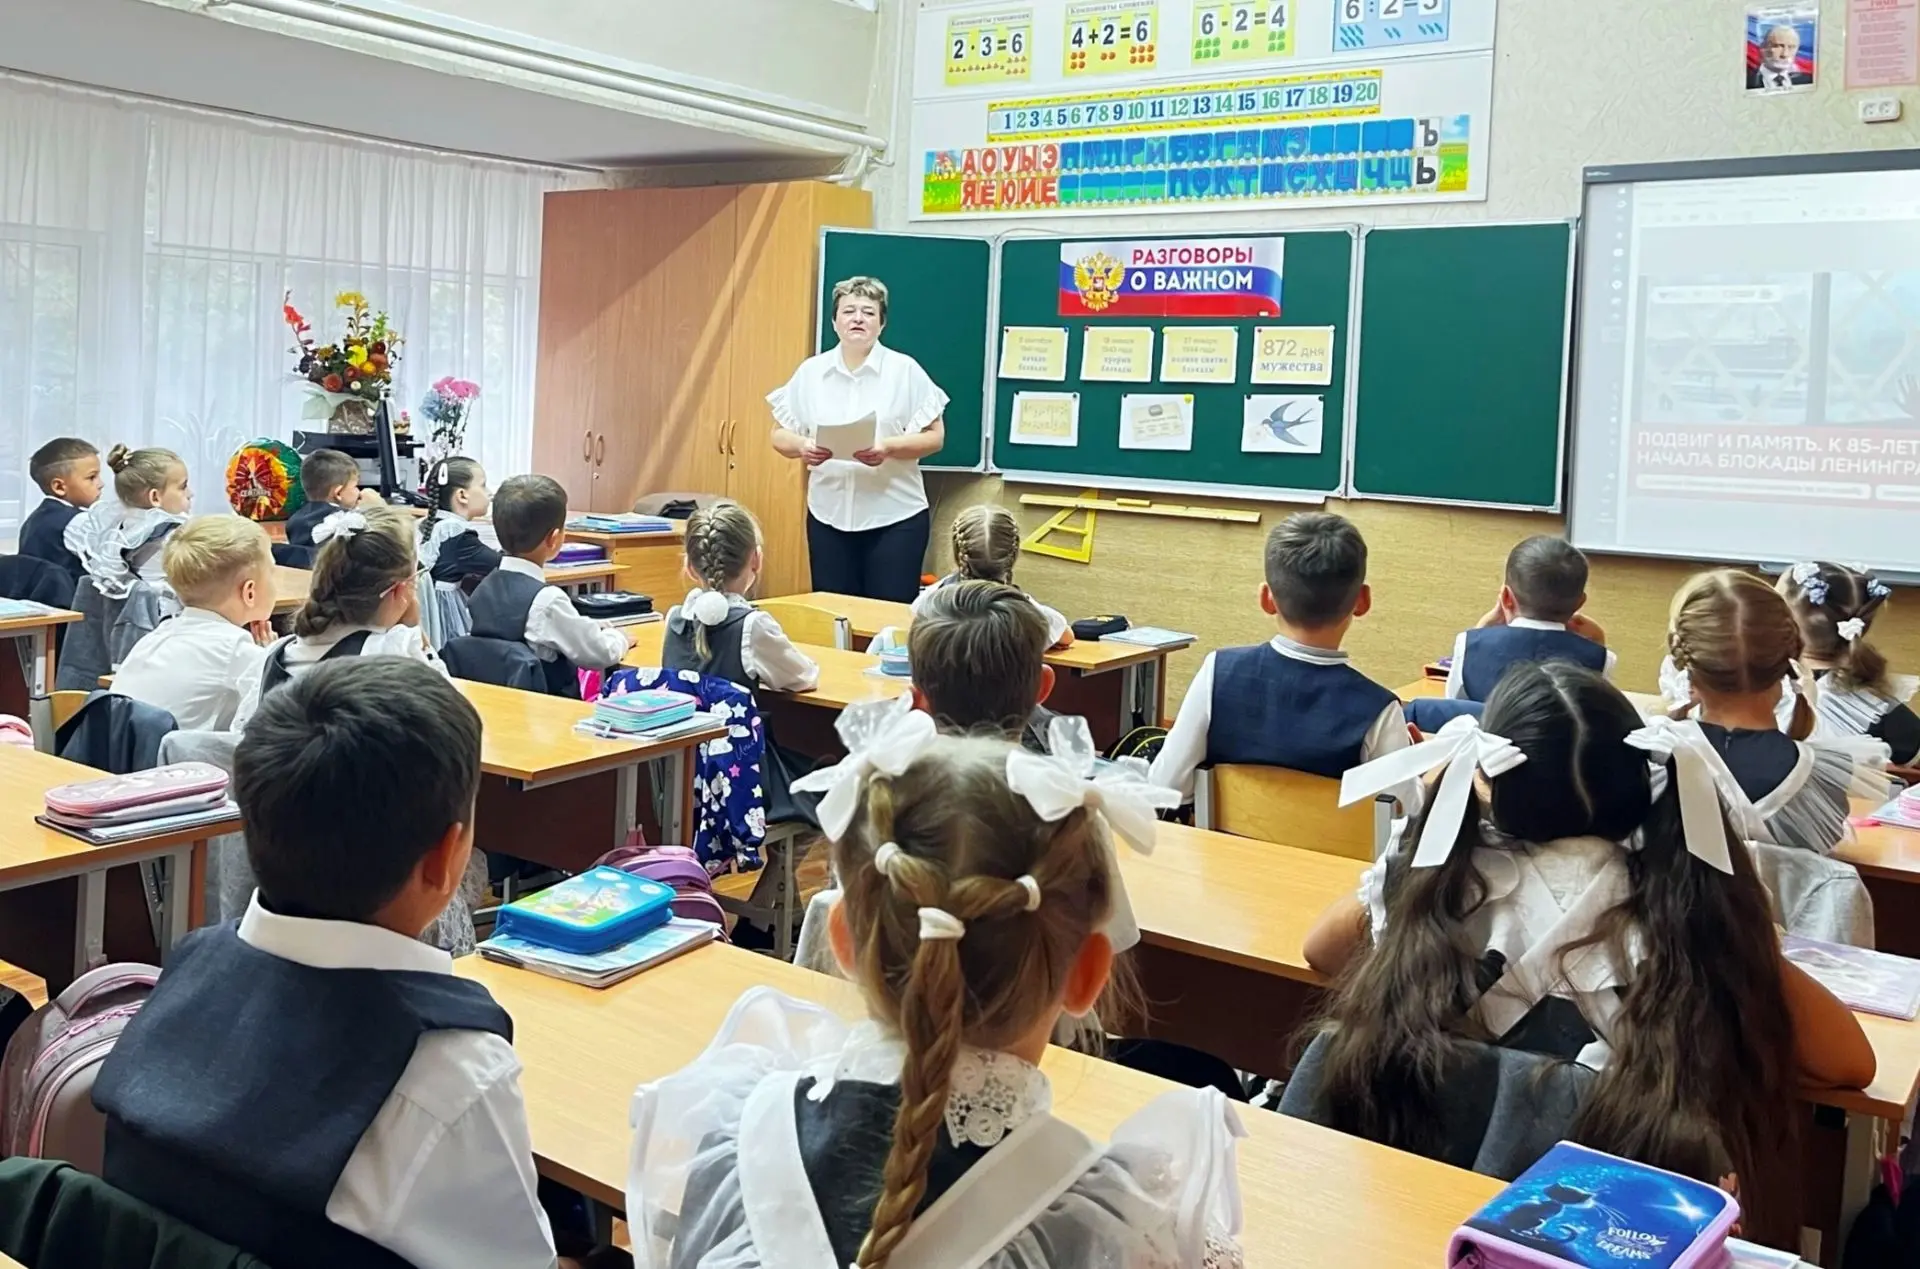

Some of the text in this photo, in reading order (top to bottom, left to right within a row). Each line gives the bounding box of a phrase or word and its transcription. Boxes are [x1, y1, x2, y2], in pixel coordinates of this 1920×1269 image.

[1201, 13, 1213, 35] 6
[1235, 9, 1248, 31] 2
[1271, 5, 1285, 27] 4
[1072, 27, 1083, 47] 4
[1103, 24, 1115, 45] 2
[1136, 20, 1148, 41] 6
[953, 40, 964, 59] 2
[981, 37, 992, 56] 3
[1012, 33, 1023, 53] 6
[1004, 82, 1378, 129] 1 2 3 4 5 6 7 8 9 10 11 12 13 14 15 16 17 18 19 20
[1132, 247, 1253, 265] РАЗГОВОРЫ
[1130, 270, 1253, 291] О ВАЖНОМ
[1263, 339, 1325, 358] 872 дня
[1260, 362, 1323, 373] мужества
[1638, 431, 1714, 449] ПОДВИГ
[1718, 433, 1732, 448] И
[1737, 434, 1823, 452] ПАМЯТЬ.
[1829, 437, 1841, 453] К
[1637, 450, 1713, 467] НАЧАЛА
[1718, 454, 1815, 473] БЛОКАДЫ
